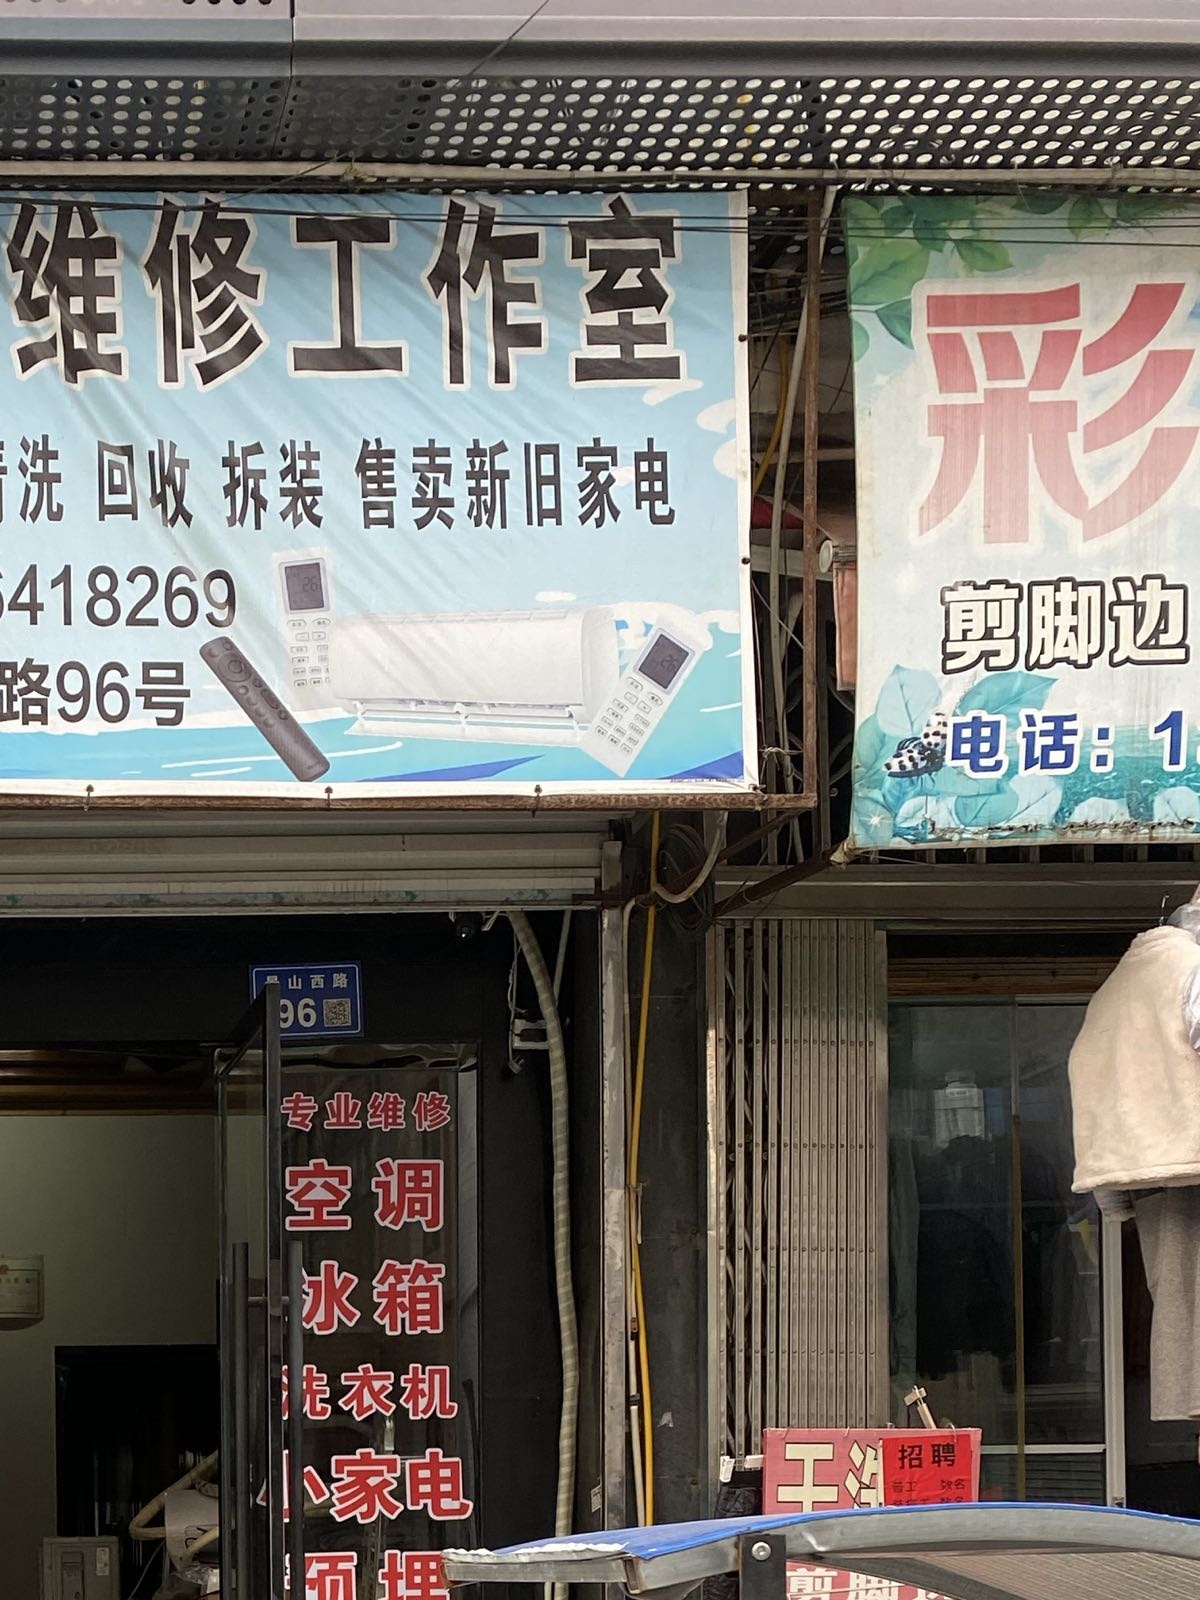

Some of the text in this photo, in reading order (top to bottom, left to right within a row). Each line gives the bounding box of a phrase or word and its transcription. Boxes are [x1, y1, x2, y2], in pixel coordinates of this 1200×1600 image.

[918, 282, 1200, 545] 彩
[97, 440, 193, 528] 回收
[221, 439, 325, 530] 拆装
[355, 436, 676, 530] 售卖新旧家电
[941, 575, 1190, 674] 剪脚边
[950, 708, 1200, 776] 电话：1
[280, 998, 317, 1029] 96
[280, 1092, 451, 1131] 专业维修
[285, 1158, 444, 1232] 空调
[302, 1259, 446, 1336] 冰箱
[281, 1363, 458, 1421] 洗衣机
[898, 1442, 956, 1469] 招聘
